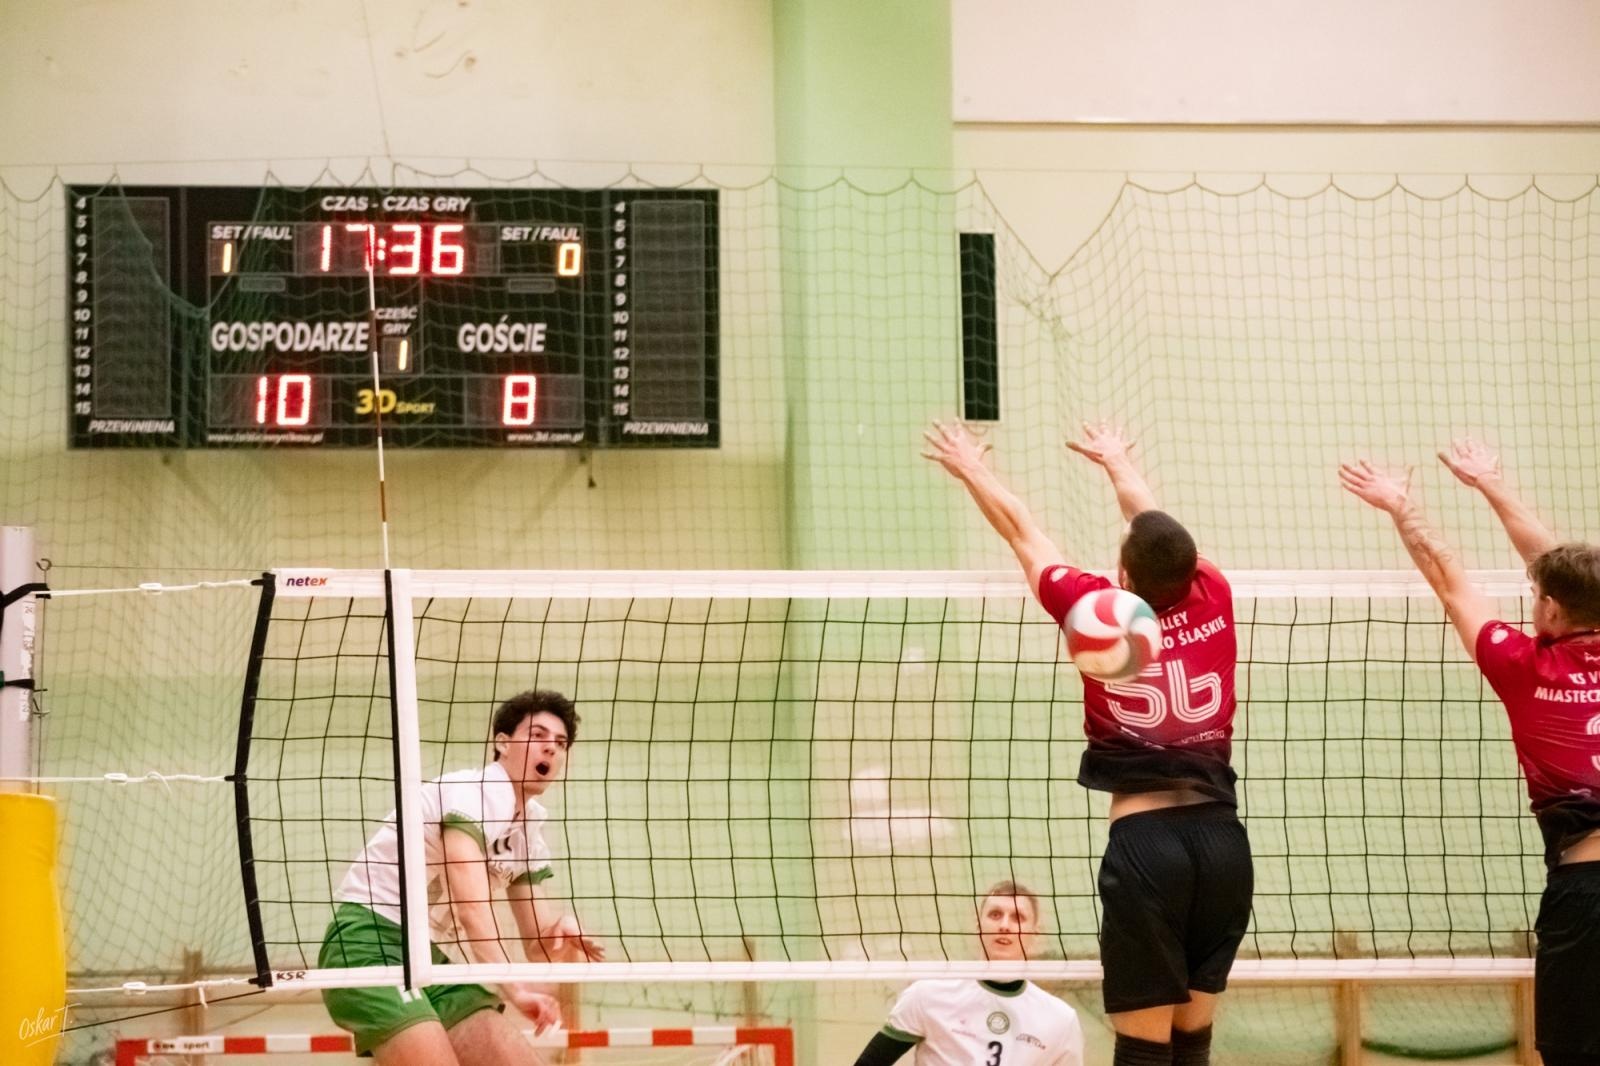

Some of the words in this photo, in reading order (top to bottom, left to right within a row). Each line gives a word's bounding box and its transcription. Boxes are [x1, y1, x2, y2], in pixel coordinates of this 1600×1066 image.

[75, 197, 87, 209] 4
[320, 196, 369, 211] CZAS
[382, 196, 430, 211] CZAS
[433, 196, 471, 211] GRY
[614, 201, 626, 213] 4
[75, 215, 87, 229] 5
[614, 219, 626, 232] 5
[76, 234, 88, 247] 6
[614, 237, 626, 250] 6
[320, 224, 465, 275] 17:36
[76, 253, 87, 266] 7
[223, 242, 232, 273] 1
[558, 242, 581, 276] 0
[615, 255, 626, 268] 7
[75, 271, 88, 285] 8
[614, 274, 627, 287] 8
[76, 289, 88, 303] 9
[615, 292, 627, 306] 9
[74, 308, 91, 321] 10
[613, 311, 629, 324] 10
[74, 328, 90, 340] 11
[382, 322, 411, 335] GRY
[458, 315, 547, 352] GOŚCIE
[211, 322, 370, 351] GOSPODARZE
[613, 330, 627, 342] 11
[74, 346, 91, 359] 12
[398, 340, 408, 371] 1
[613, 347, 630, 360] 12
[74, 365, 91, 377] 13
[613, 366, 630, 380] 13
[75, 383, 91, 396] 14
[613, 384, 630, 397] 14
[256, 375, 311, 426] 10
[355, 389, 397, 414] 3D
[503, 375, 537, 426] 8
[75, 402, 91, 415] 15
[613, 402, 629, 415] 15
[286, 576, 328, 587] netex
[1161, 611, 1188, 630] LLEY
[1177, 616, 1227, 646] ŚLĄSKIE
[986, 1041, 1003, 1066] 3
